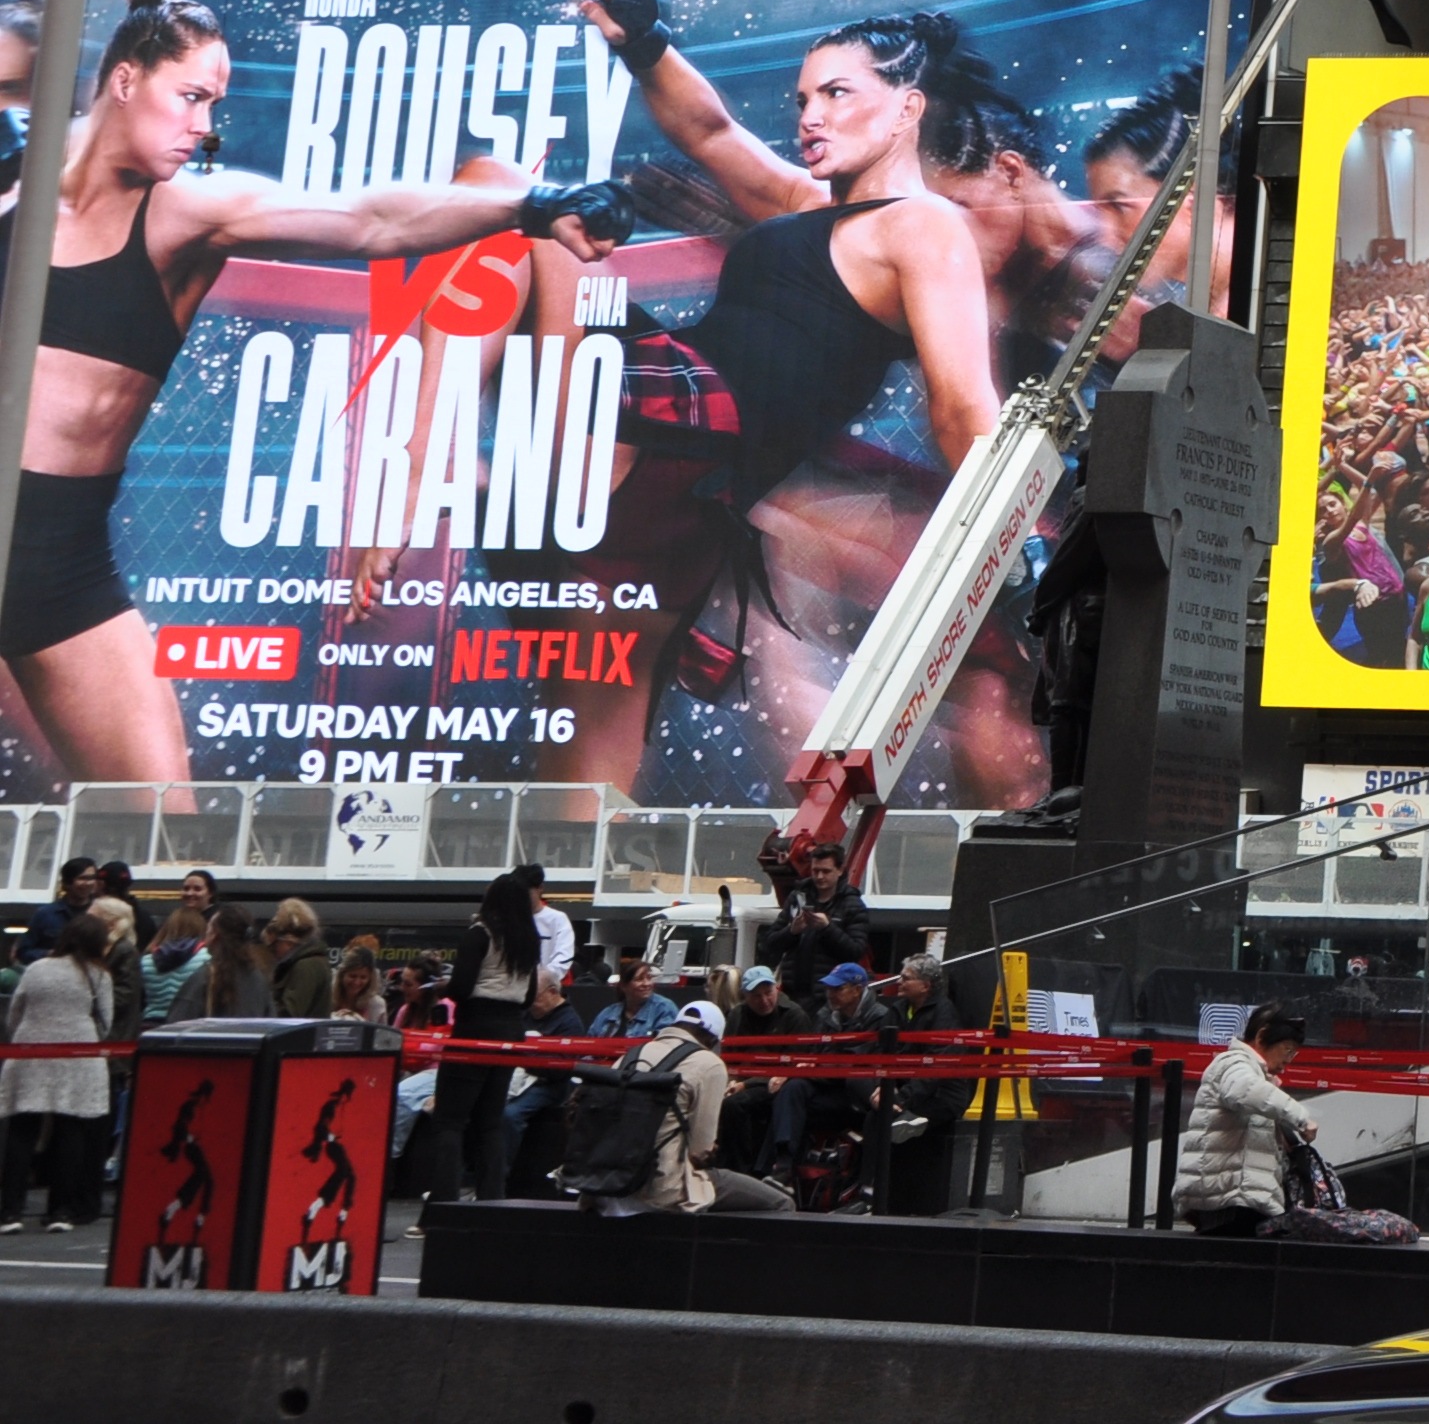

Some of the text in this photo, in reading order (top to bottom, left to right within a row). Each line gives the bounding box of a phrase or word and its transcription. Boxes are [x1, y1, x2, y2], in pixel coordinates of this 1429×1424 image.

[281, 22, 635, 194] ROUSEY
[366, 226, 537, 337] VS
[573, 276, 628, 328] GINA
[219, 330, 625, 553] CARANO
[1176, 442, 1215, 470] FRANCIS
[1226, 457, 1259, 483] DUFFY
[1184, 491, 1246, 519] CATHOLIC PRIEST
[145, 577, 252, 605] INTUIT
[382, 578, 445, 607] LOS
[450, 579, 606, 614] ANGELES,
[613, 582, 659, 610] CA
[884, 468, 1046, 767] NORTH SHORE NEON SIGN CO.
[194, 628, 640, 686] LIVE ONLY ON NETFLIX
[197, 702, 575, 744] SATURDAY MAY 16
[298, 749, 464, 785] 9 PM ET
[357, 814, 421, 824] ANDAMIO
[1063, 1010, 1092, 1029] Times
[146, 1244, 204, 1290] MJ
[290, 1240, 348, 1289] MJ
